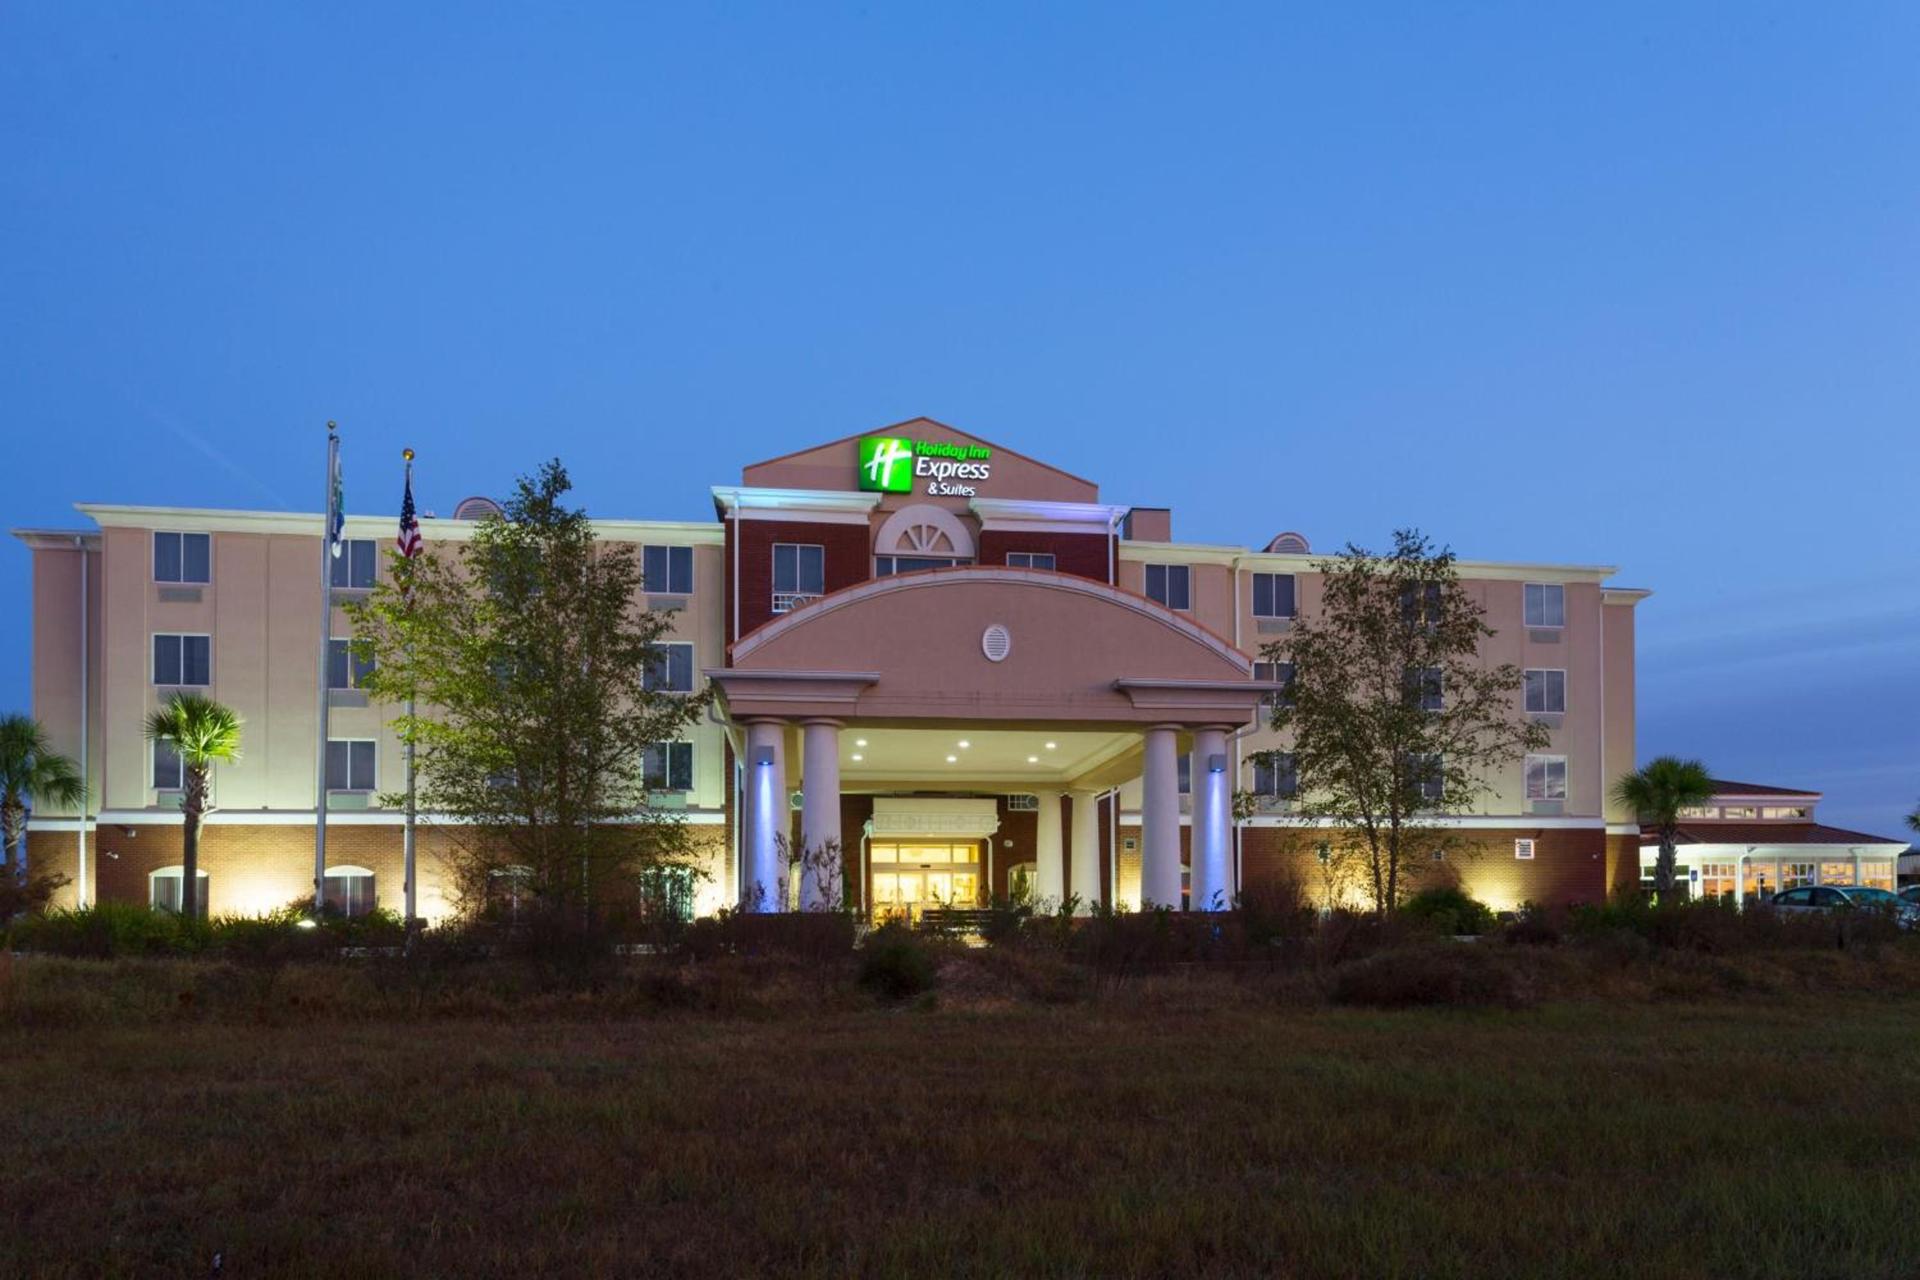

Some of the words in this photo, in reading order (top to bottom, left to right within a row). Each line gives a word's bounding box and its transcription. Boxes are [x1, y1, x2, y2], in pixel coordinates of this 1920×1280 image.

[915, 441, 967, 460] Holiday
[969, 444, 991, 458] Inn
[864, 439, 912, 488] H
[916, 457, 990, 481] Express
[928, 482, 937, 495] &
[939, 482, 976, 497] Suites
